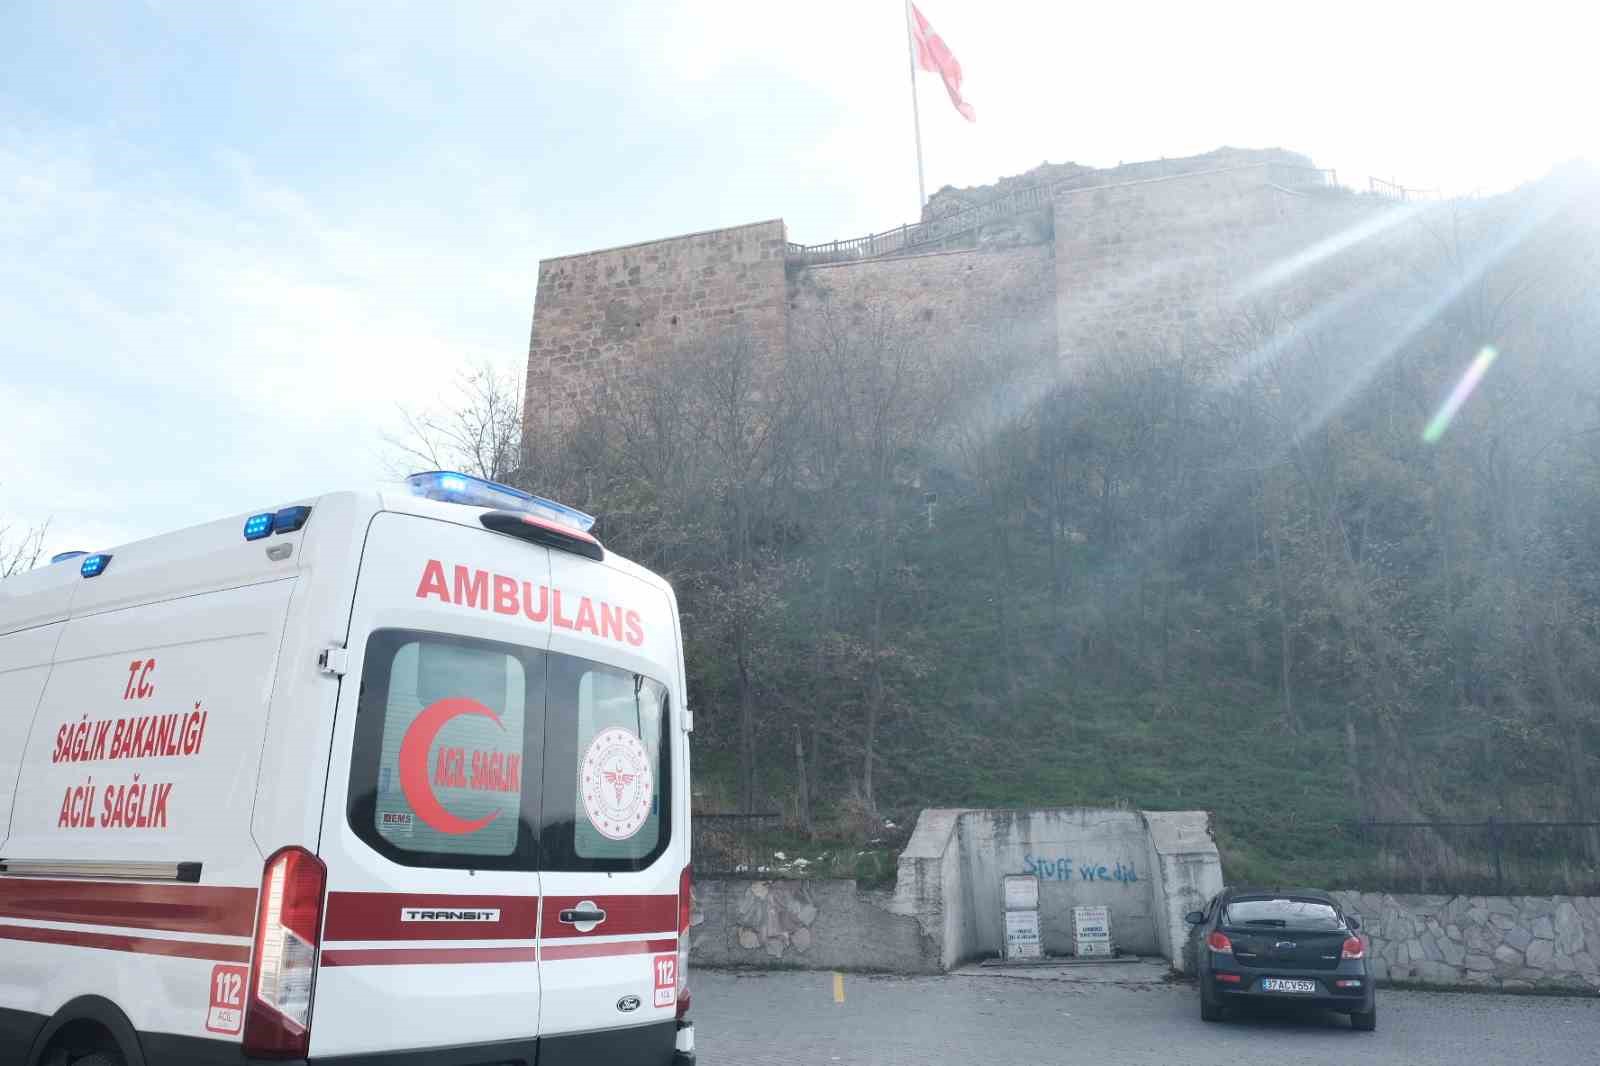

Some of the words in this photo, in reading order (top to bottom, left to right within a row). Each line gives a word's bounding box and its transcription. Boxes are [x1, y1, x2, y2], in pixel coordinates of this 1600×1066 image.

[416, 559, 645, 647] AMBULANS
[124, 658, 156, 700] T.C.
[53, 713, 112, 763] SAĞLIK
[109, 700, 207, 760] BAKANLIĞI
[58, 776, 96, 828] ACİL
[101, 773, 172, 828] SAĞLIK
[406, 910, 495, 921] TRANSIT
[216, 971, 242, 1005] 112
[656, 959, 674, 986] 112
